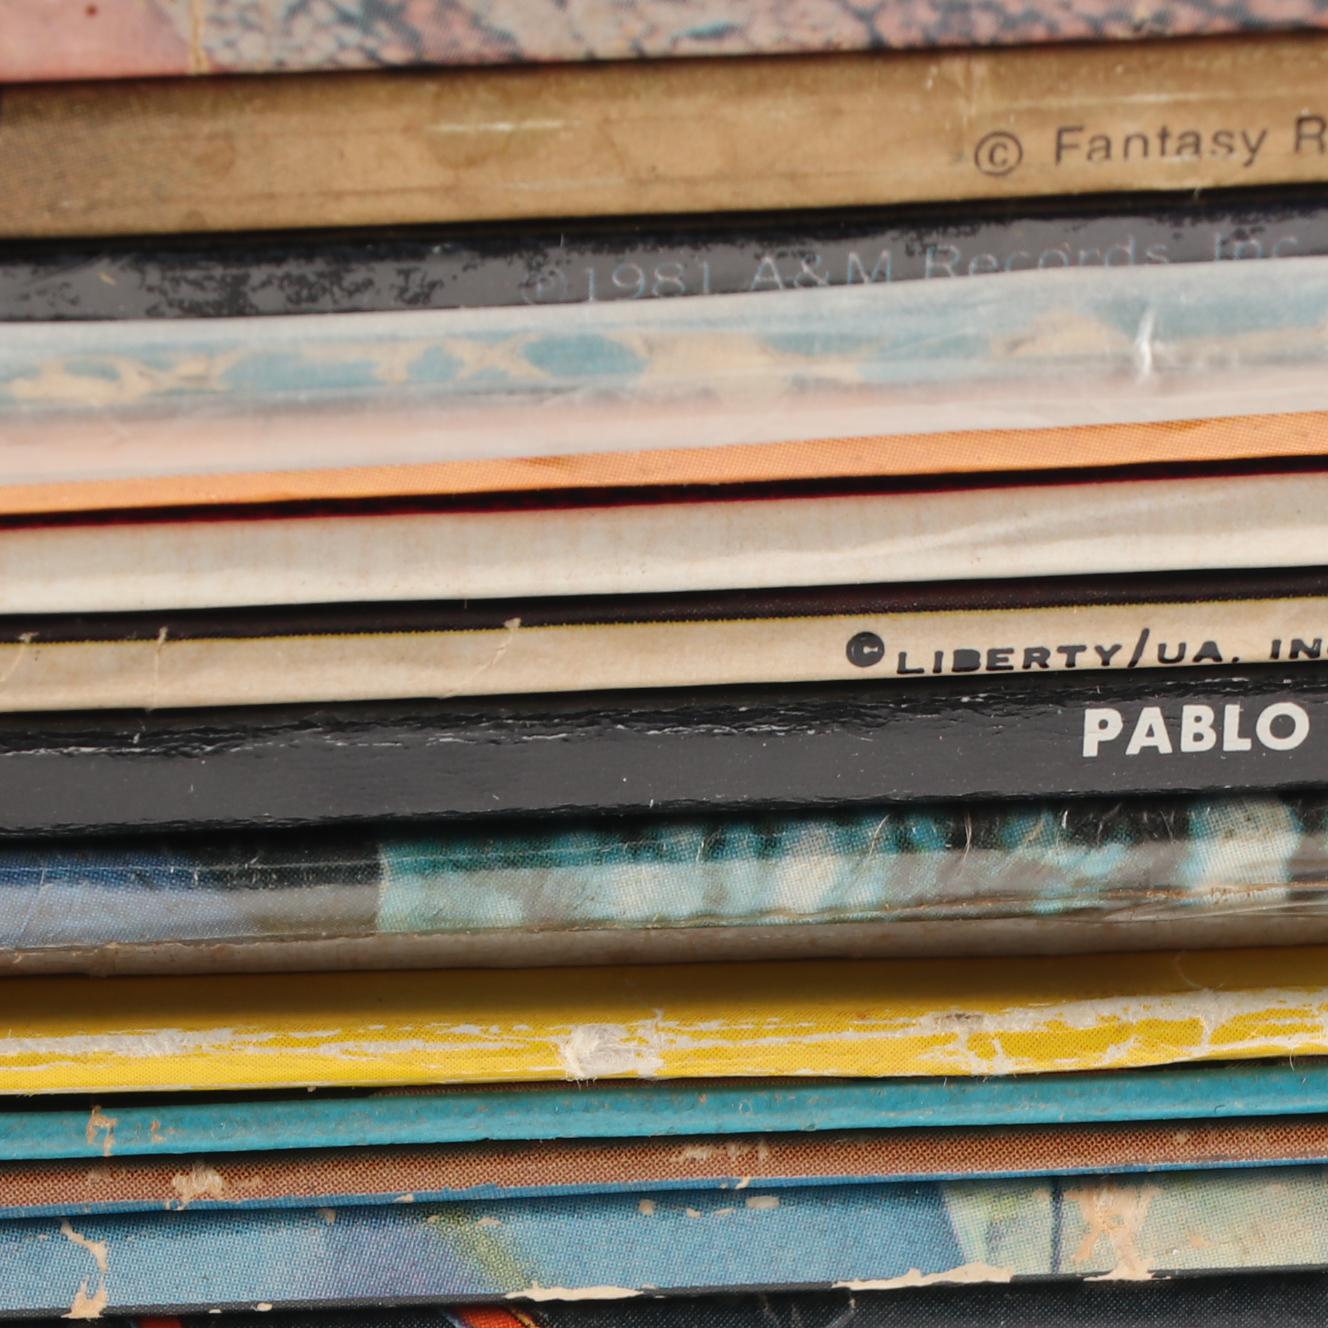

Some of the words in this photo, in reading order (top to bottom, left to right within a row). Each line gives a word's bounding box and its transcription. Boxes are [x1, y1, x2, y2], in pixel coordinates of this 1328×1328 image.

[1053, 125, 1269, 168] Fantasy
[748, 248, 894, 292] A&M
[926, 232, 1170, 282] Records
[1082, 700, 1312, 758] PABLO
